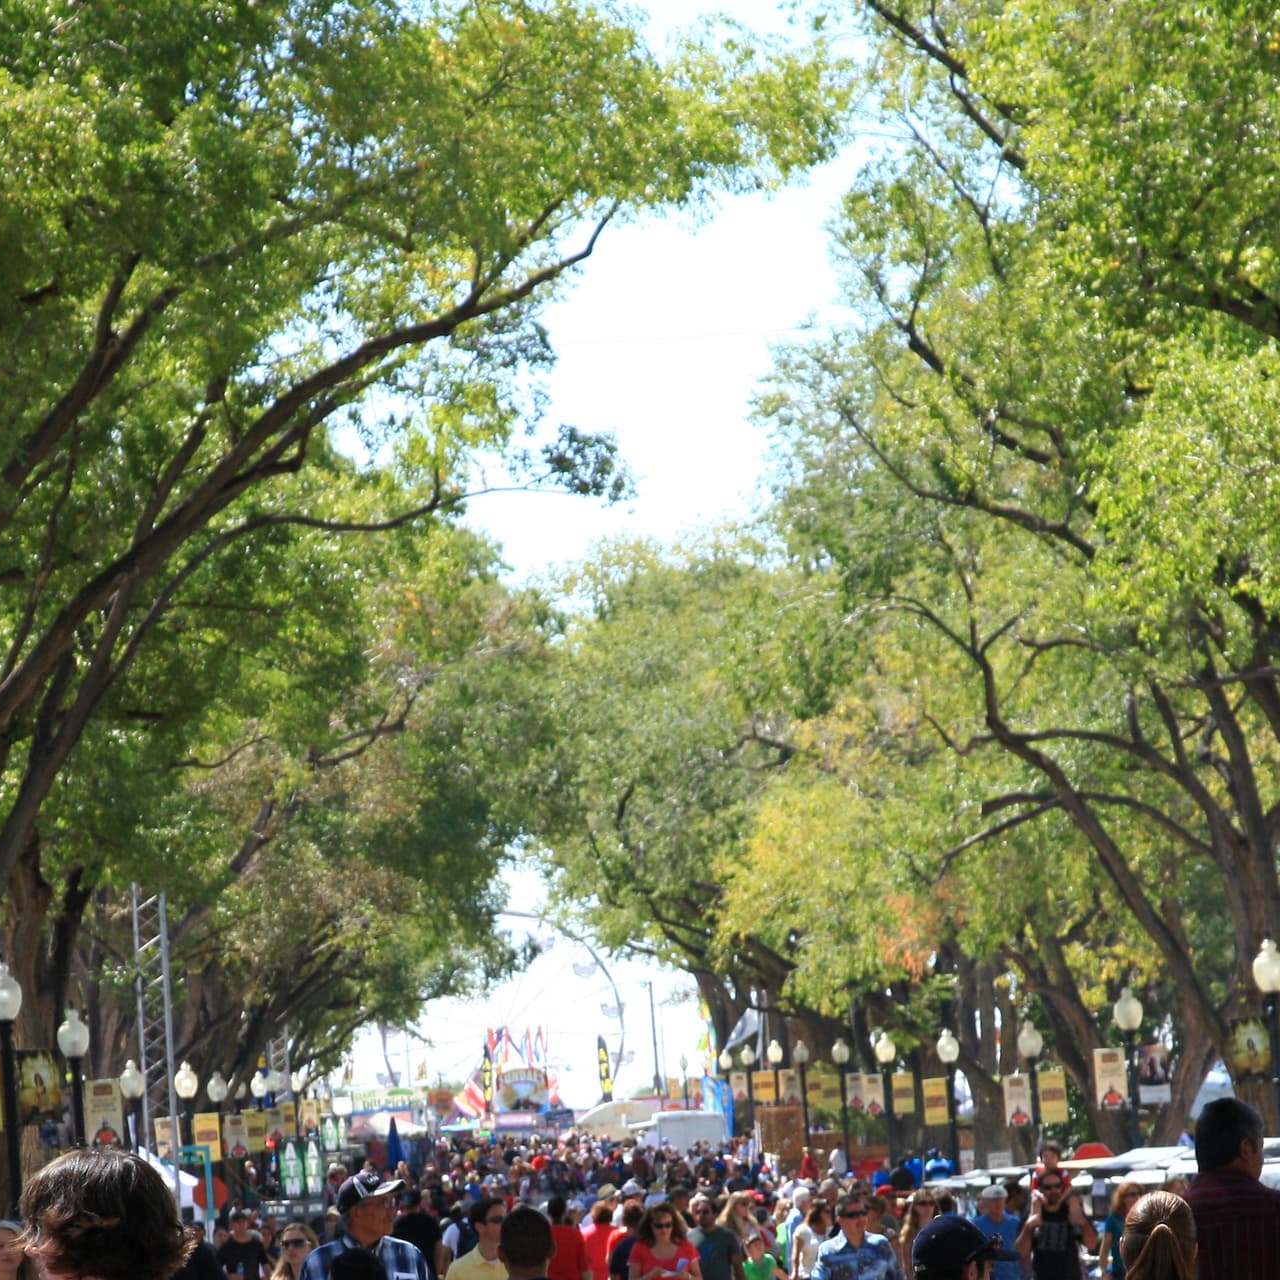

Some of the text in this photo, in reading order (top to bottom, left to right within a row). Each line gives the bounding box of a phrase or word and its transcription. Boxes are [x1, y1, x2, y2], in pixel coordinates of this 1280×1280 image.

[285, 1141, 300, 1195] ATM
[307, 1140, 322, 1194] ATM
[267, 1205, 286, 1214] ATM
